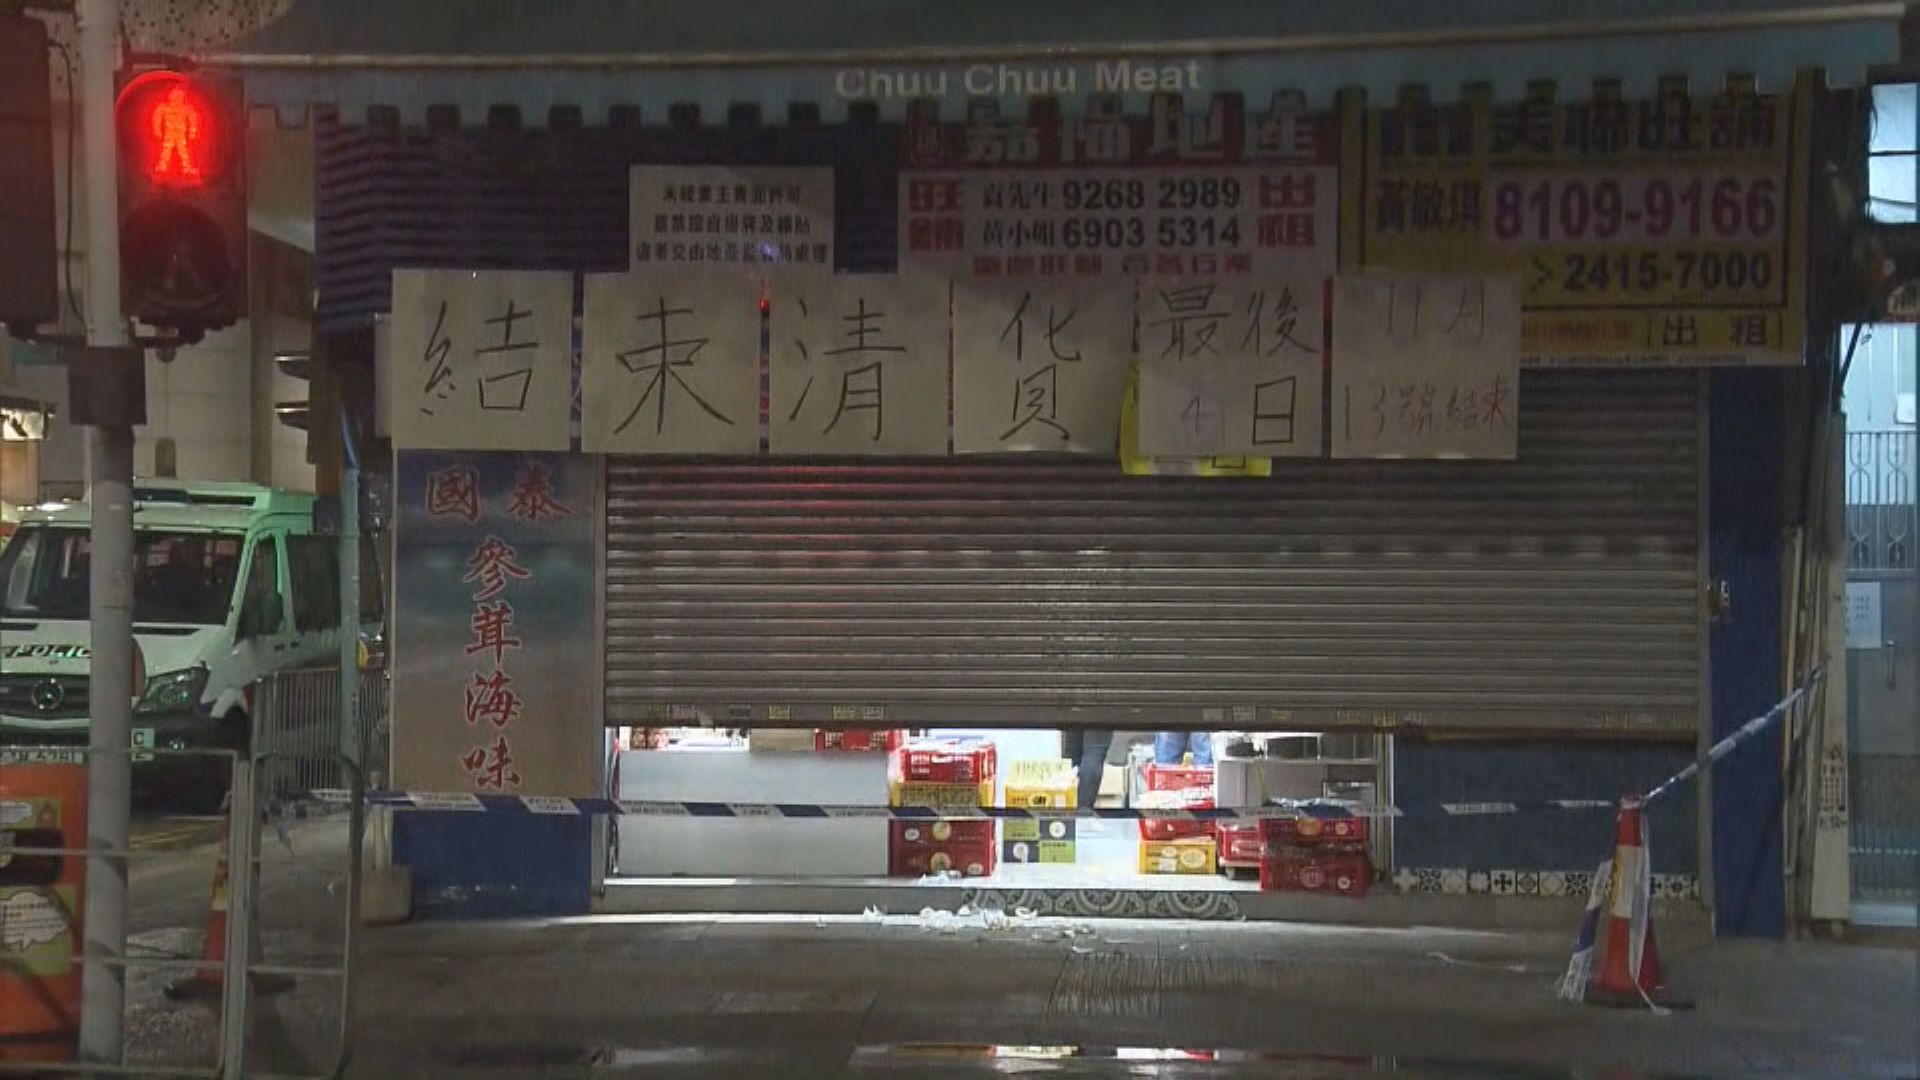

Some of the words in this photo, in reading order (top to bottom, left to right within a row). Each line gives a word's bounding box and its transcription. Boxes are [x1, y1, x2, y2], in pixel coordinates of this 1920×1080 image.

[835, 65, 948, 98] Chuu
[964, 63, 1077, 95] Chuu
[1094, 57, 1201, 92] Meat
[1062, 178, 1145, 210] 9268
[1158, 176, 1242, 209] 2989
[1493, 177, 1777, 239] 8109-9166
[1062, 216, 1145, 248] 6903
[1158, 214, 1242, 247] 5314
[1563, 253, 1773, 292] 2415-7000
[1148, 283, 1319, 362] 最後
[1662, 313, 1769, 348] 出租
